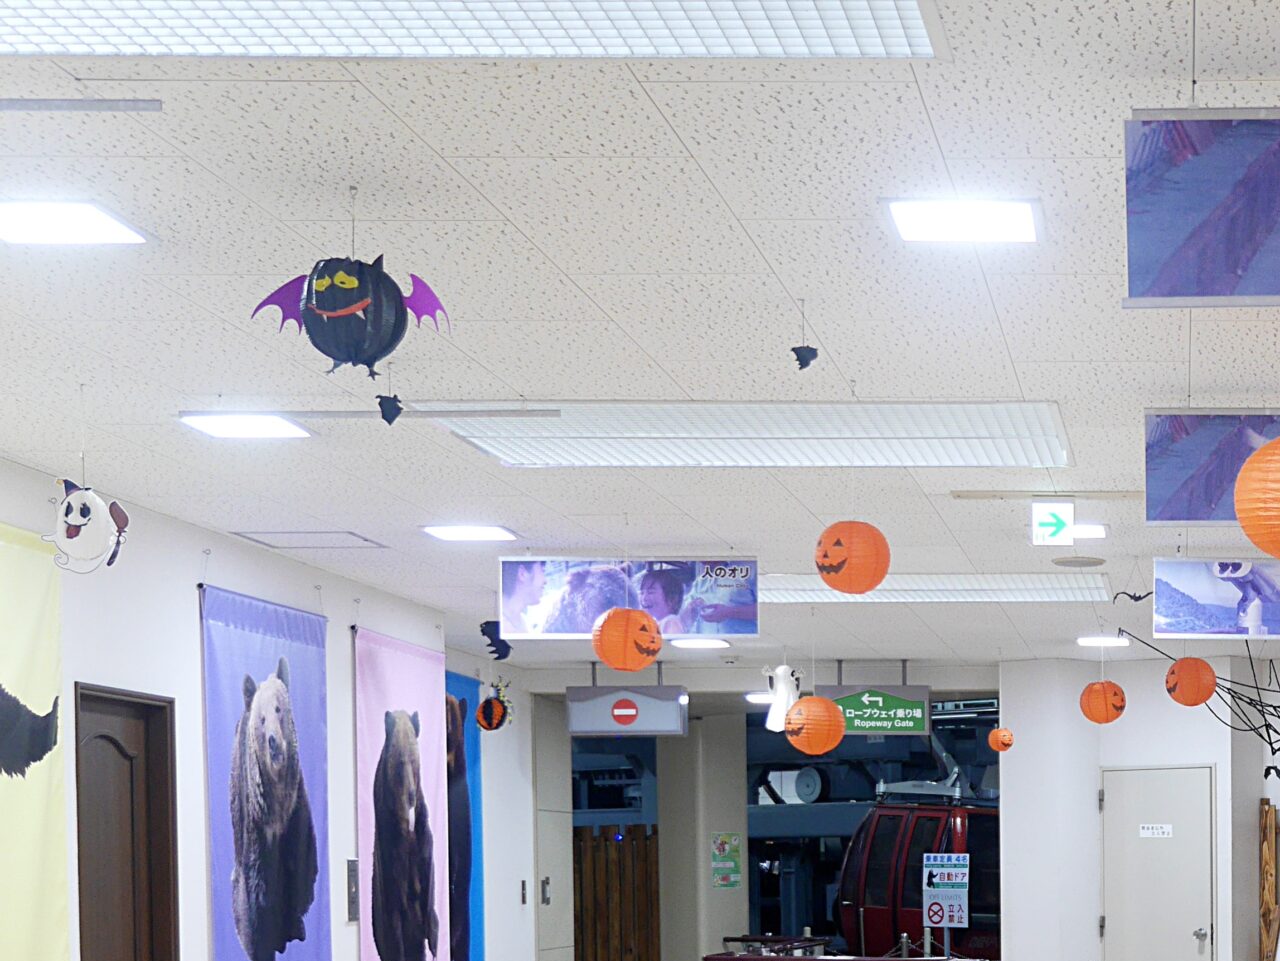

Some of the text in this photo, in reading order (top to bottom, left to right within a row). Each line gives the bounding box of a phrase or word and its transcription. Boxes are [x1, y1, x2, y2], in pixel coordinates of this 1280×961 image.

[702, 566, 749, 579] 人のオリ
[845, 708, 922, 718] ロープウェイ乗り場
[854, 719, 914, 729] Ropeway Gate
[939, 872, 967, 882] 自動ドア
